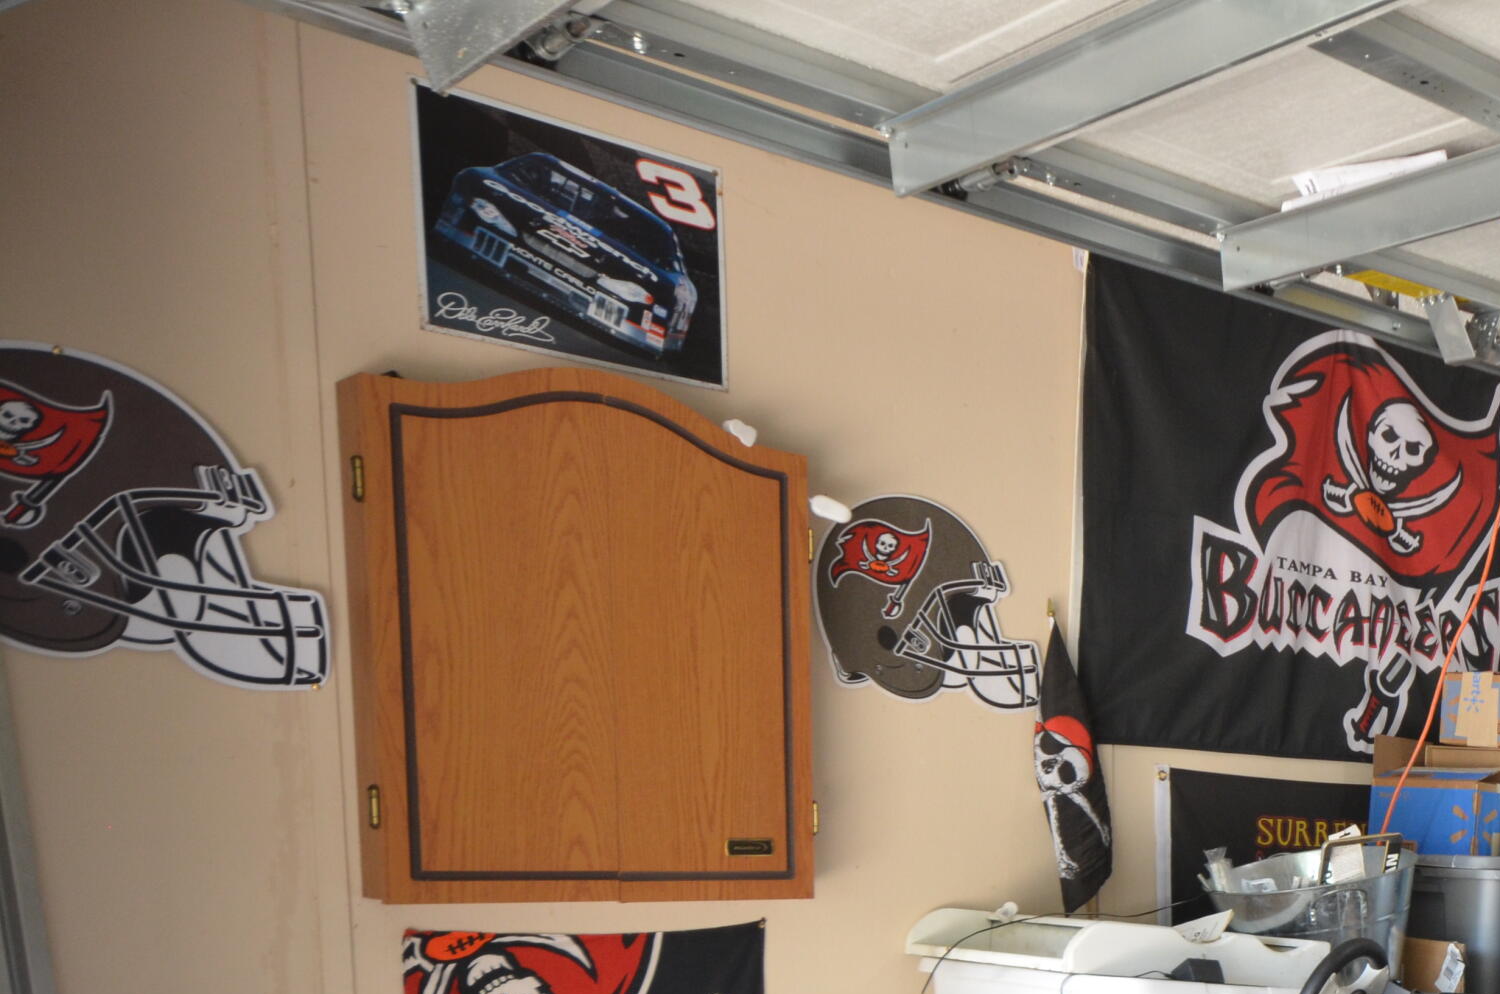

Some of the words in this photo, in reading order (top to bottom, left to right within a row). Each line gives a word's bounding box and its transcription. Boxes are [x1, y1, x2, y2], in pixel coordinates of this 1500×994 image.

[635, 158, 717, 231] 3
[512, 243, 553, 272] MONTE
[553, 267, 605, 298] CARLO
[1276, 555, 1338, 581] TAMPA
[1349, 569, 1389, 588] BAY
